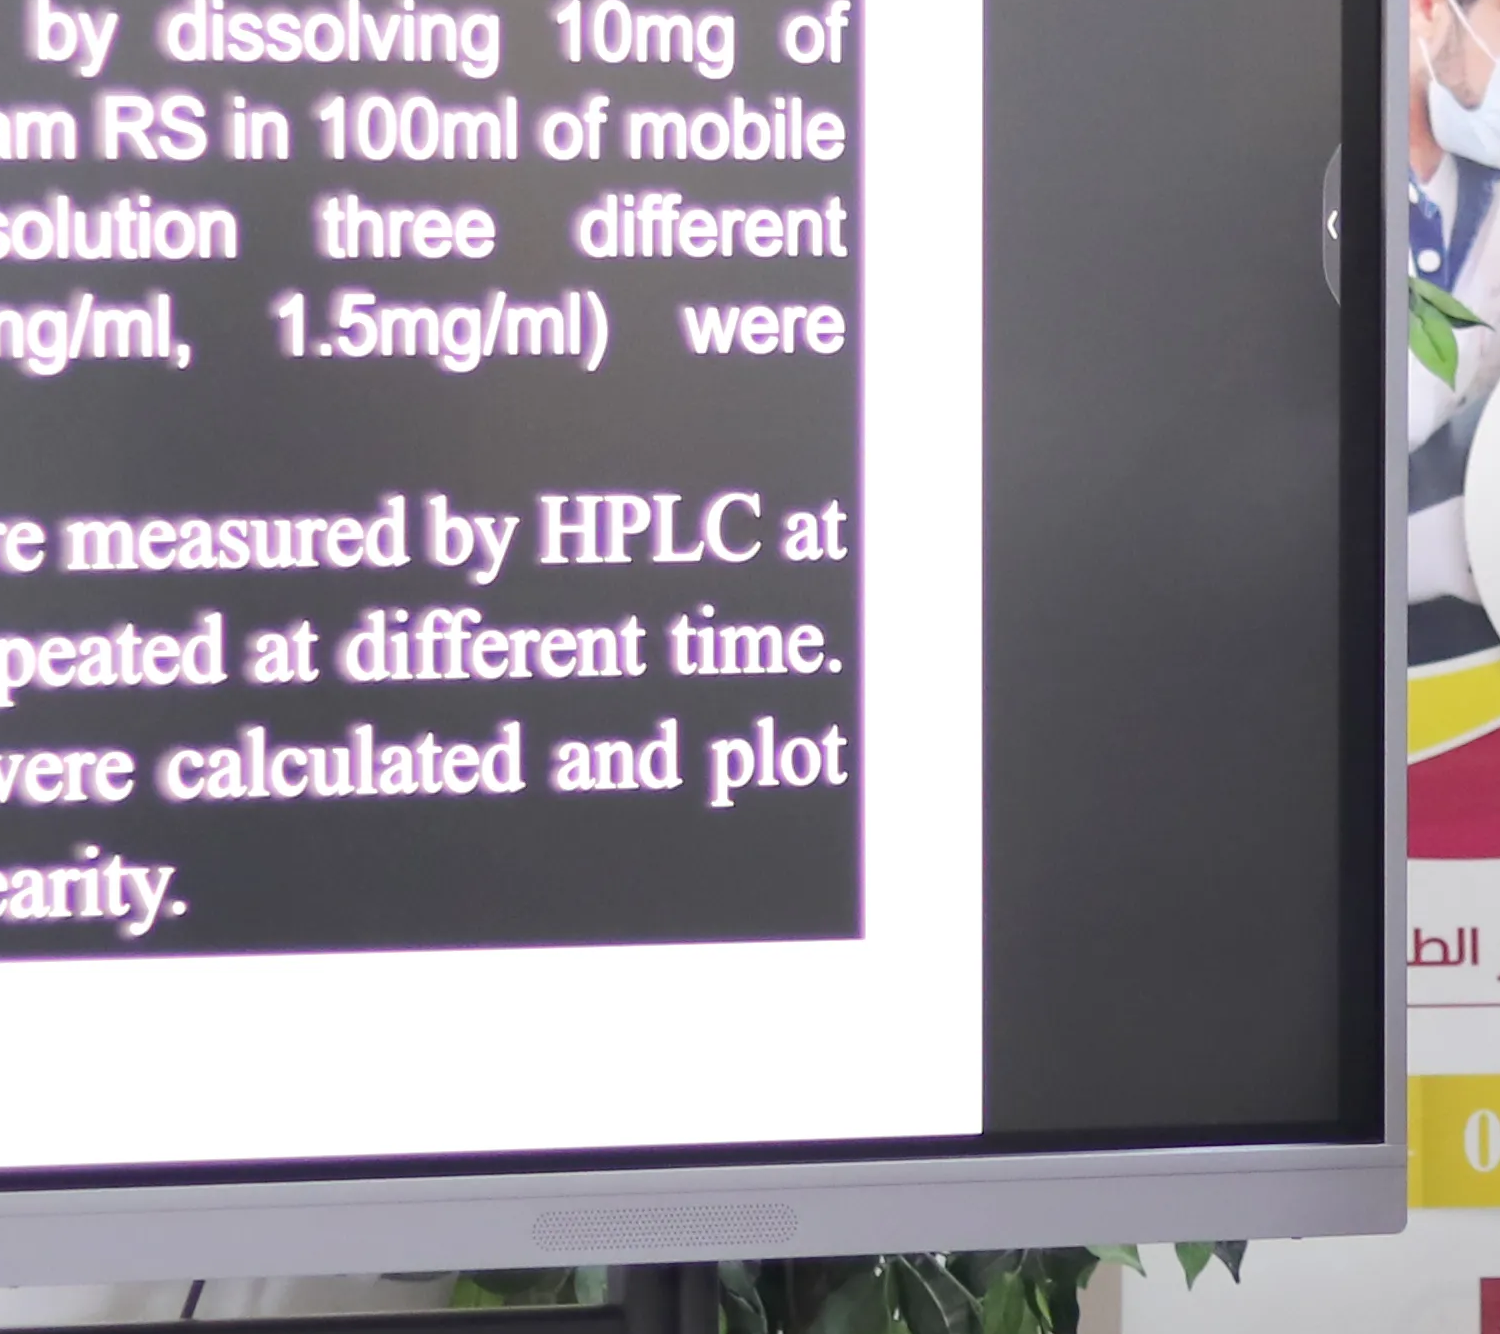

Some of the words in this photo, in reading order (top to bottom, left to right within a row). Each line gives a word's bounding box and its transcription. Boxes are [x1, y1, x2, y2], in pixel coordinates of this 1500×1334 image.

[784, 0, 846, 62] of
[98, 91, 207, 159] RS
[228, 95, 288, 158] in
[319, 95, 516, 159] 100ml
[538, 95, 609, 159] of
[626, 96, 844, 160] mobile
[319, 194, 494, 258] three
[576, 192, 846, 257] different
[277, 290, 607, 372] 1.5mg/ml)
[684, 305, 844, 353] were
[66, 495, 409, 569] measured
[428, 495, 518, 584] by
[540, 492, 759, 562] HPLC
[784, 499, 846, 560] at
[252, 621, 318, 682] at
[342, 608, 645, 680] different
[671, 604, 840, 674] time.
[163, 721, 524, 798] calculated
[554, 718, 681, 789] and
[711, 716, 846, 806] plot
[1405, 926, 1480, 967] الط
